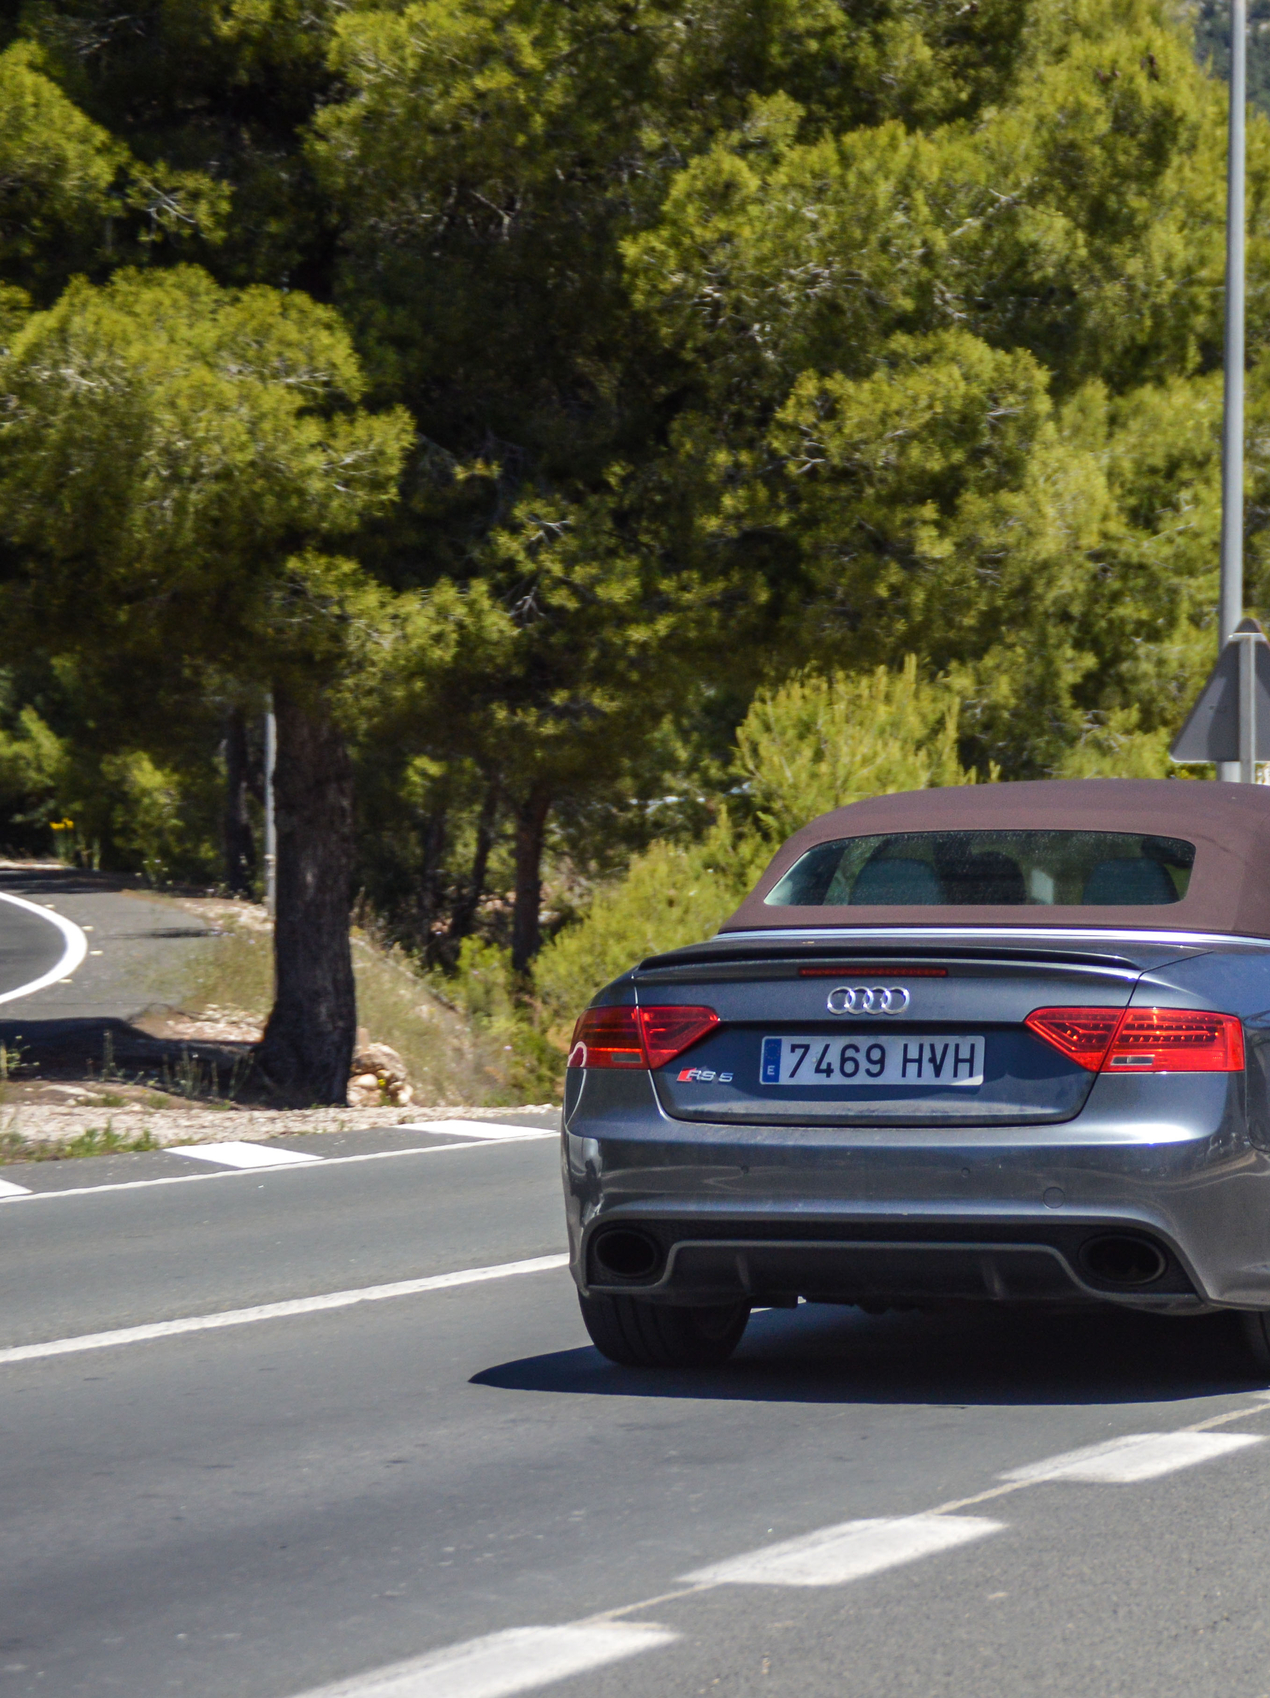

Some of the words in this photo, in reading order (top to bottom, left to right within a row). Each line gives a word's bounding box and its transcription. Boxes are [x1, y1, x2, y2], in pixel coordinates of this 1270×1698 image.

[789, 1043, 886, 1078] 7469
[901, 1043, 976, 1078] HVH
[686, 1070, 716, 1082] RS
[718, 1072, 733, 1083] 5
[767, 1065, 776, 1076] E
